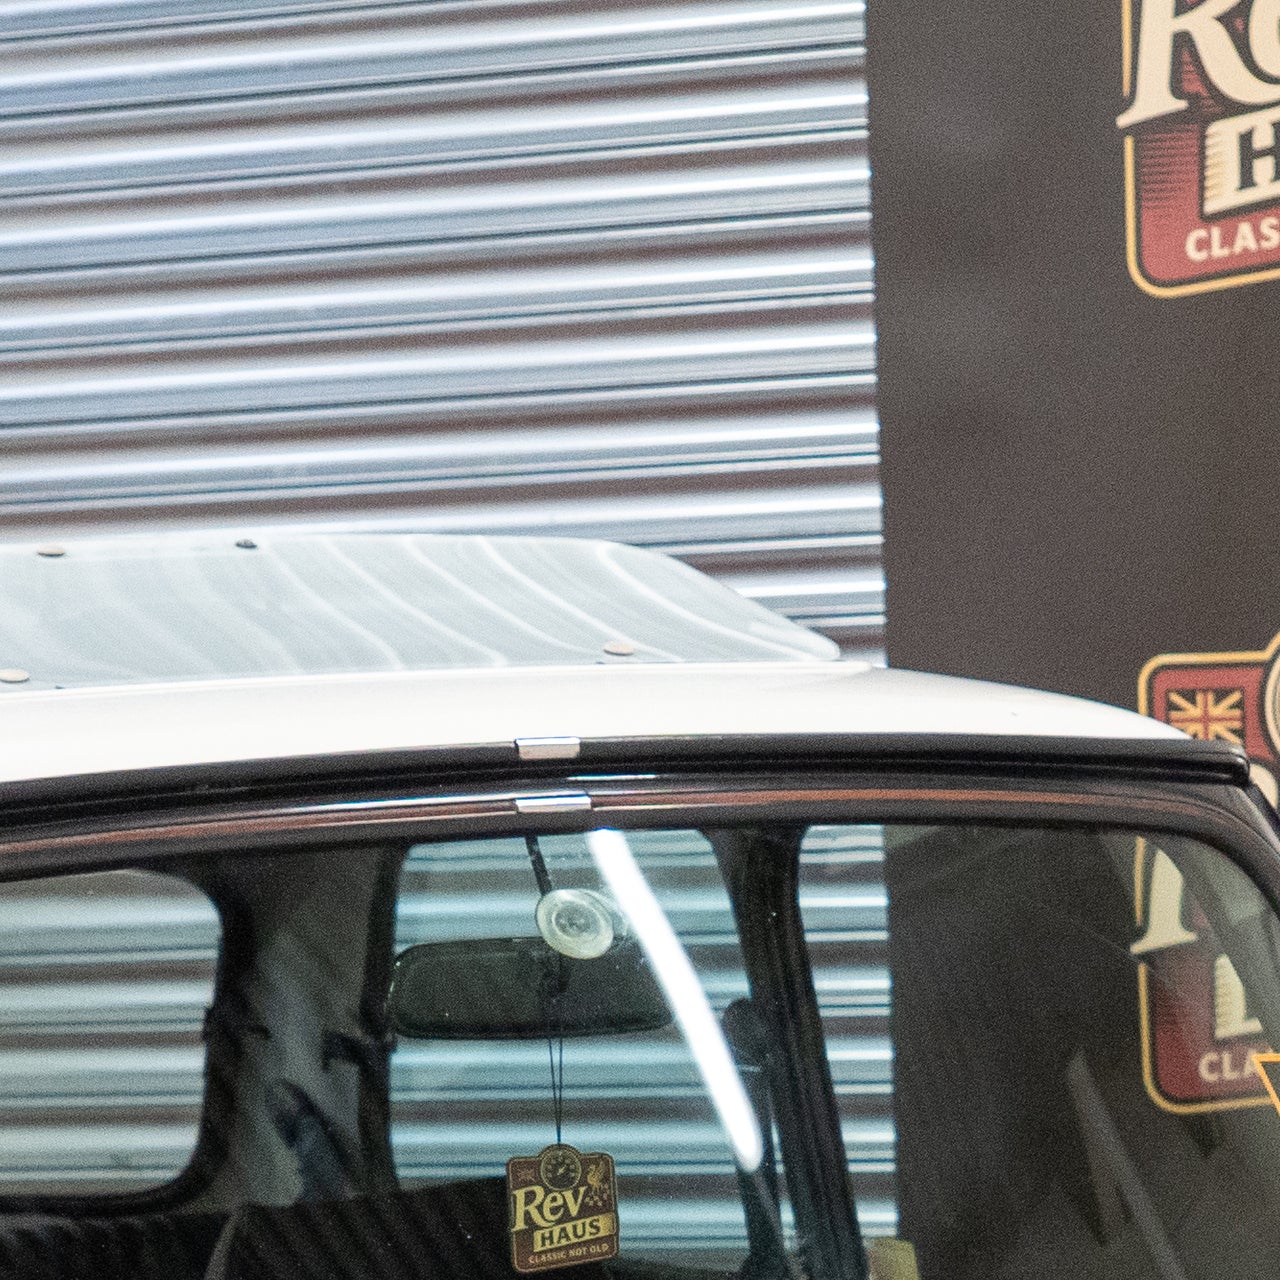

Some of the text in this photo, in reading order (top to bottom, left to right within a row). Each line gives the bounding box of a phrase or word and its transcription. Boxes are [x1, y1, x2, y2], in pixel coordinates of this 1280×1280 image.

[511, 1185, 588, 1232] Rev
[540, 1218, 601, 1248] HAUS
[528, 1242, 609, 1264] CLASSIC NOT OLD
